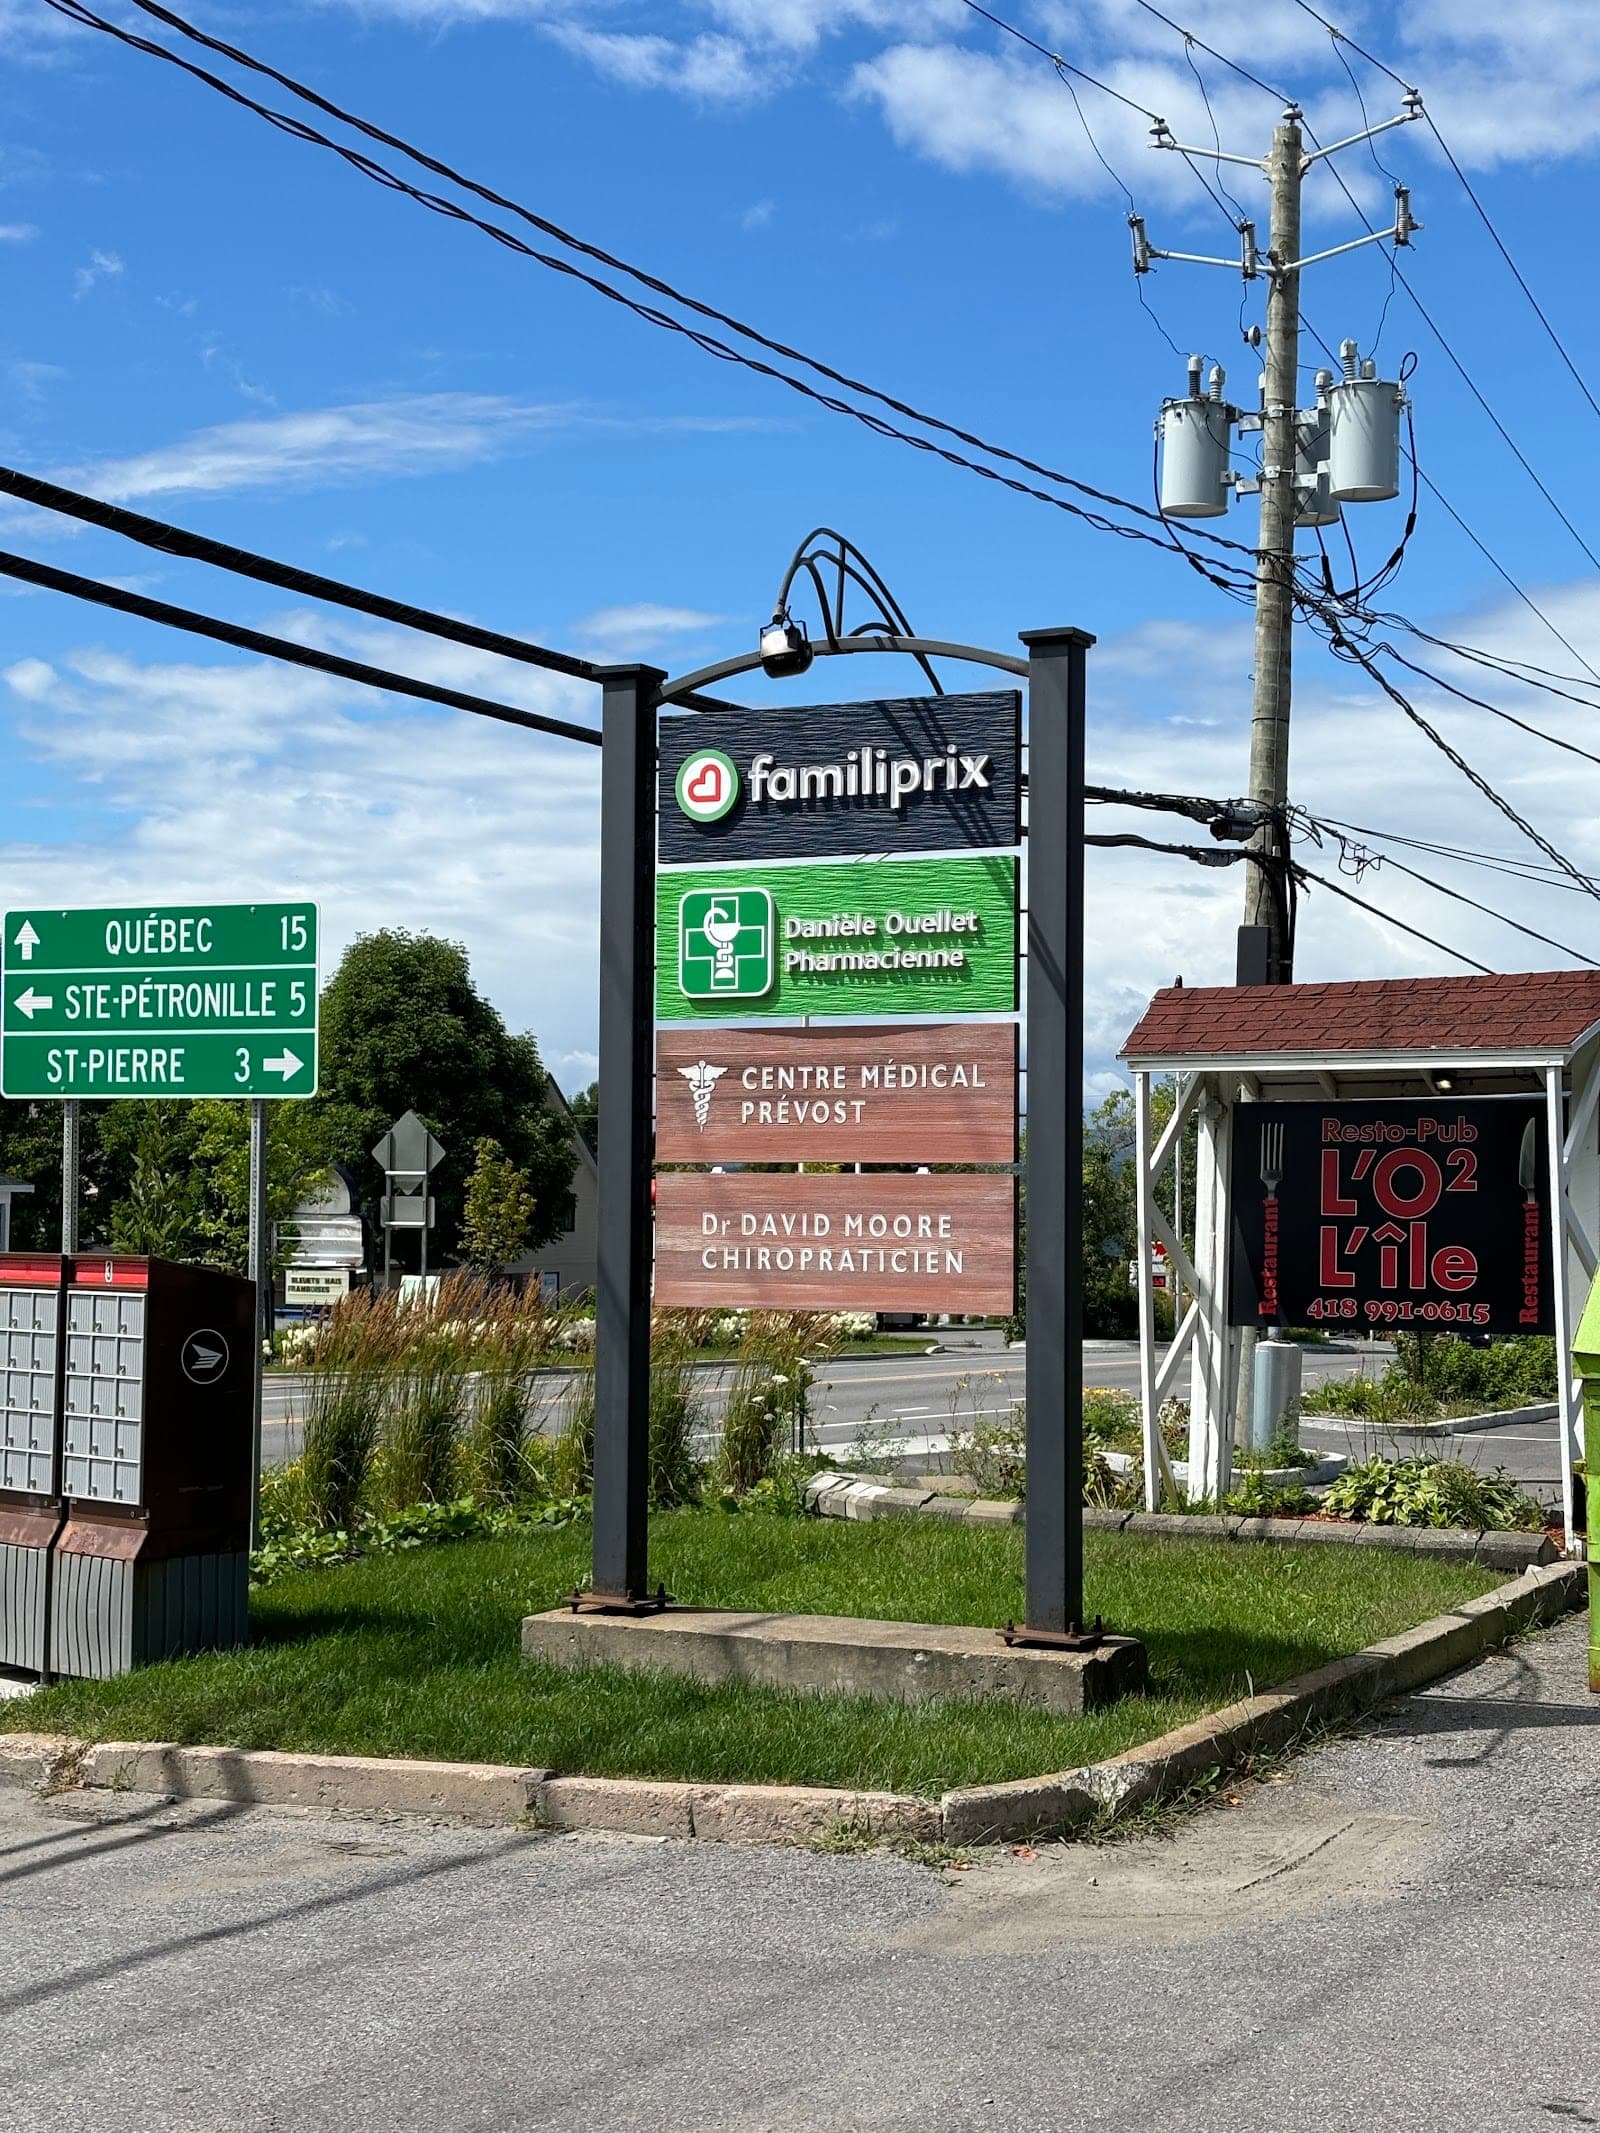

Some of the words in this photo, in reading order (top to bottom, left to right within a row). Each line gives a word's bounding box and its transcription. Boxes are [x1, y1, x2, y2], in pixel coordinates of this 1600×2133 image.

[748, 744, 990, 809] familiprix
[105, 913, 213, 955] QUÉBEC
[281, 915, 307, 951] 15
[785, 911, 877, 939] Danièle
[884, 909, 979, 935] Ouellet
[785, 946, 964, 973] Pharmacienne
[64, 977, 276, 1019] STE-PÉTRONILLE
[289, 981, 306, 1017] 5
[46, 1049, 185, 1083] ST-PIERRE
[234, 1048, 250, 1083] 3
[741, 1065, 847, 1090] CENTRE
[860, 1059, 987, 1089] MÉDICAL
[741, 1095, 866, 1125] PRÉVOST
[1322, 1116, 1478, 1142] Resto-Pub
[702, 1212, 731, 1236] Dr
[741, 1213, 831, 1236] DAVID
[845, 1214, 952, 1238] MOORE
[702, 1247, 964, 1274] CHIROPRATICIEN
[1258, 1198, 1279, 1315] Restaurant
[1519, 1201, 1539, 1324] Restaurant
[1307, 1298, 1357, 1319] 418
[1364, 1301, 1490, 1324] 991-0615
